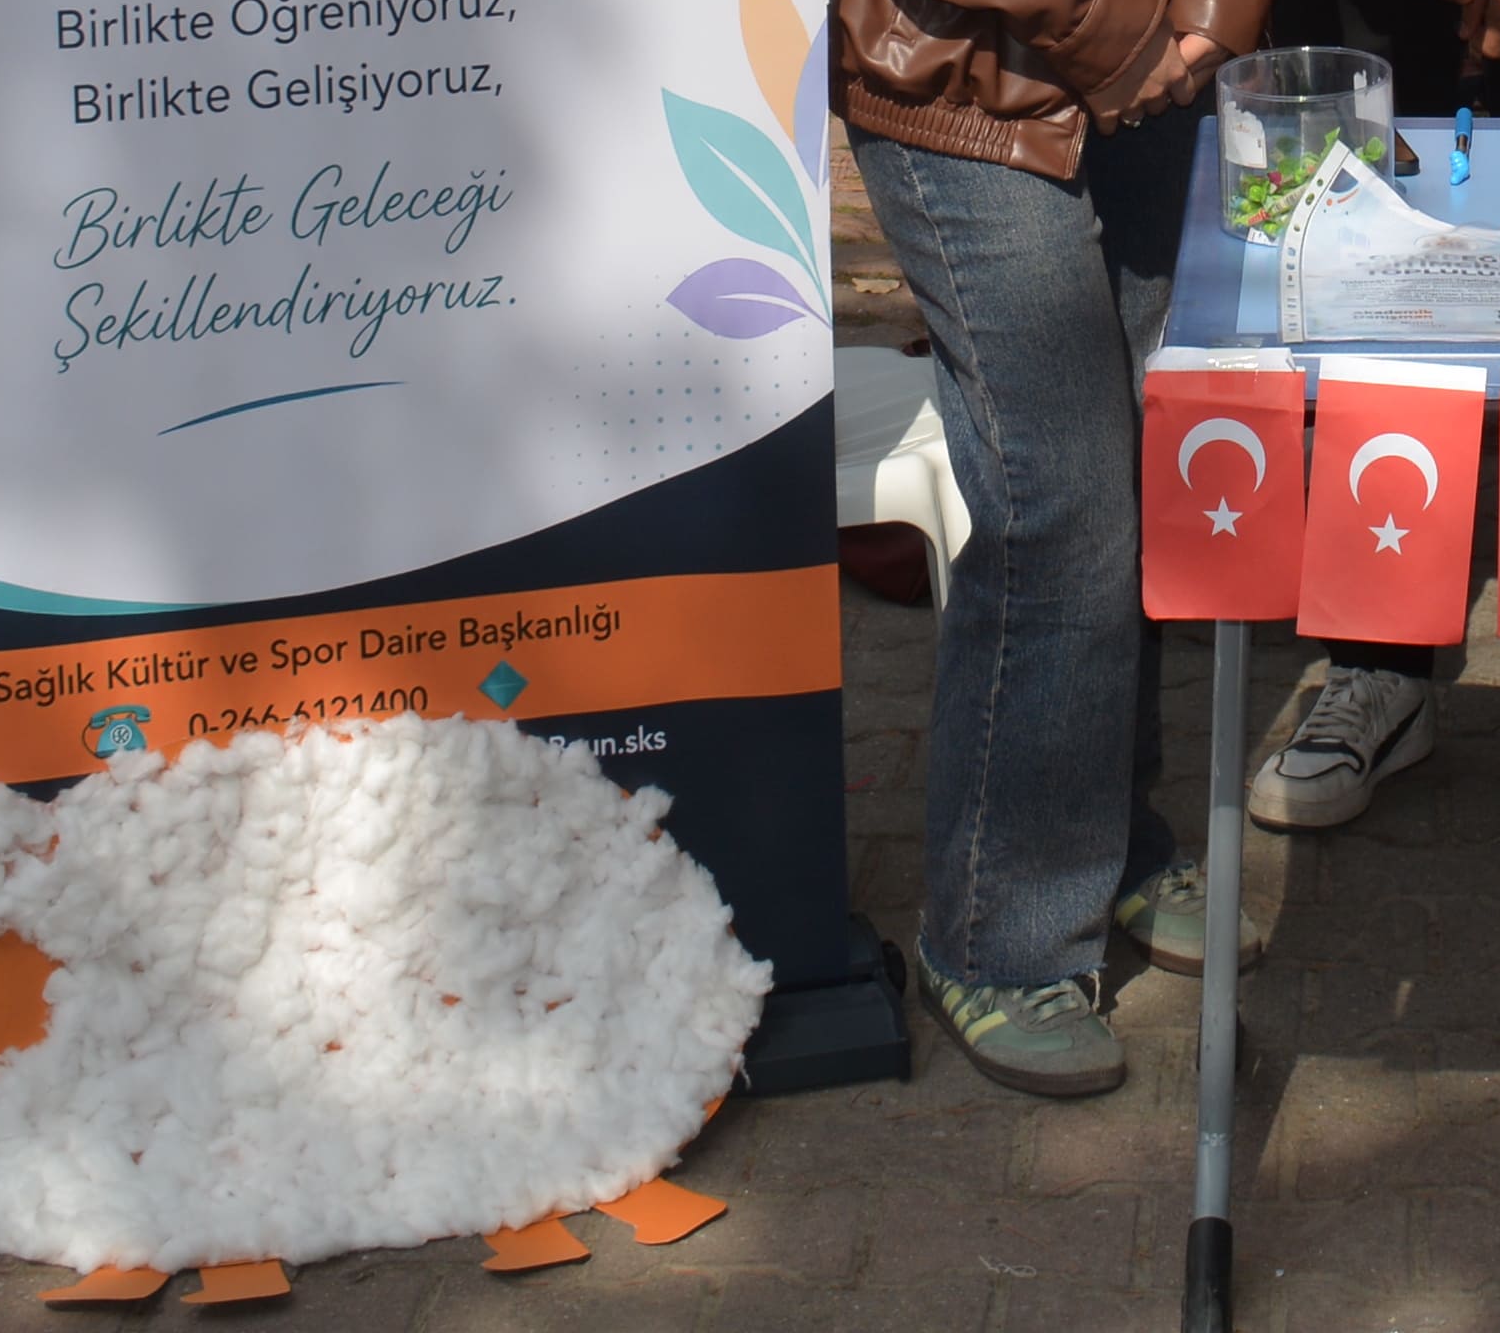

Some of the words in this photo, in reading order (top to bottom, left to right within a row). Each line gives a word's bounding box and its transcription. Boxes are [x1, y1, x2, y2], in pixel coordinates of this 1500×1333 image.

[55, 0, 214, 52] Birlikte
[70, 74, 230, 125] Birlikte
[246, 54, 504, 115] Gelişiyoruz,
[53, 173, 270, 272] Birlikte
[290, 161, 513, 256] Geleceği
[53, 264, 517, 374] Şekillendiriyoruz.
[106, 653, 210, 692] Kültür
[221, 647, 258, 676] ve
[271, 632, 348, 677] Spor
[360, 625, 447, 661] Daire
[458, 604, 624, 653] Başkanlığı
